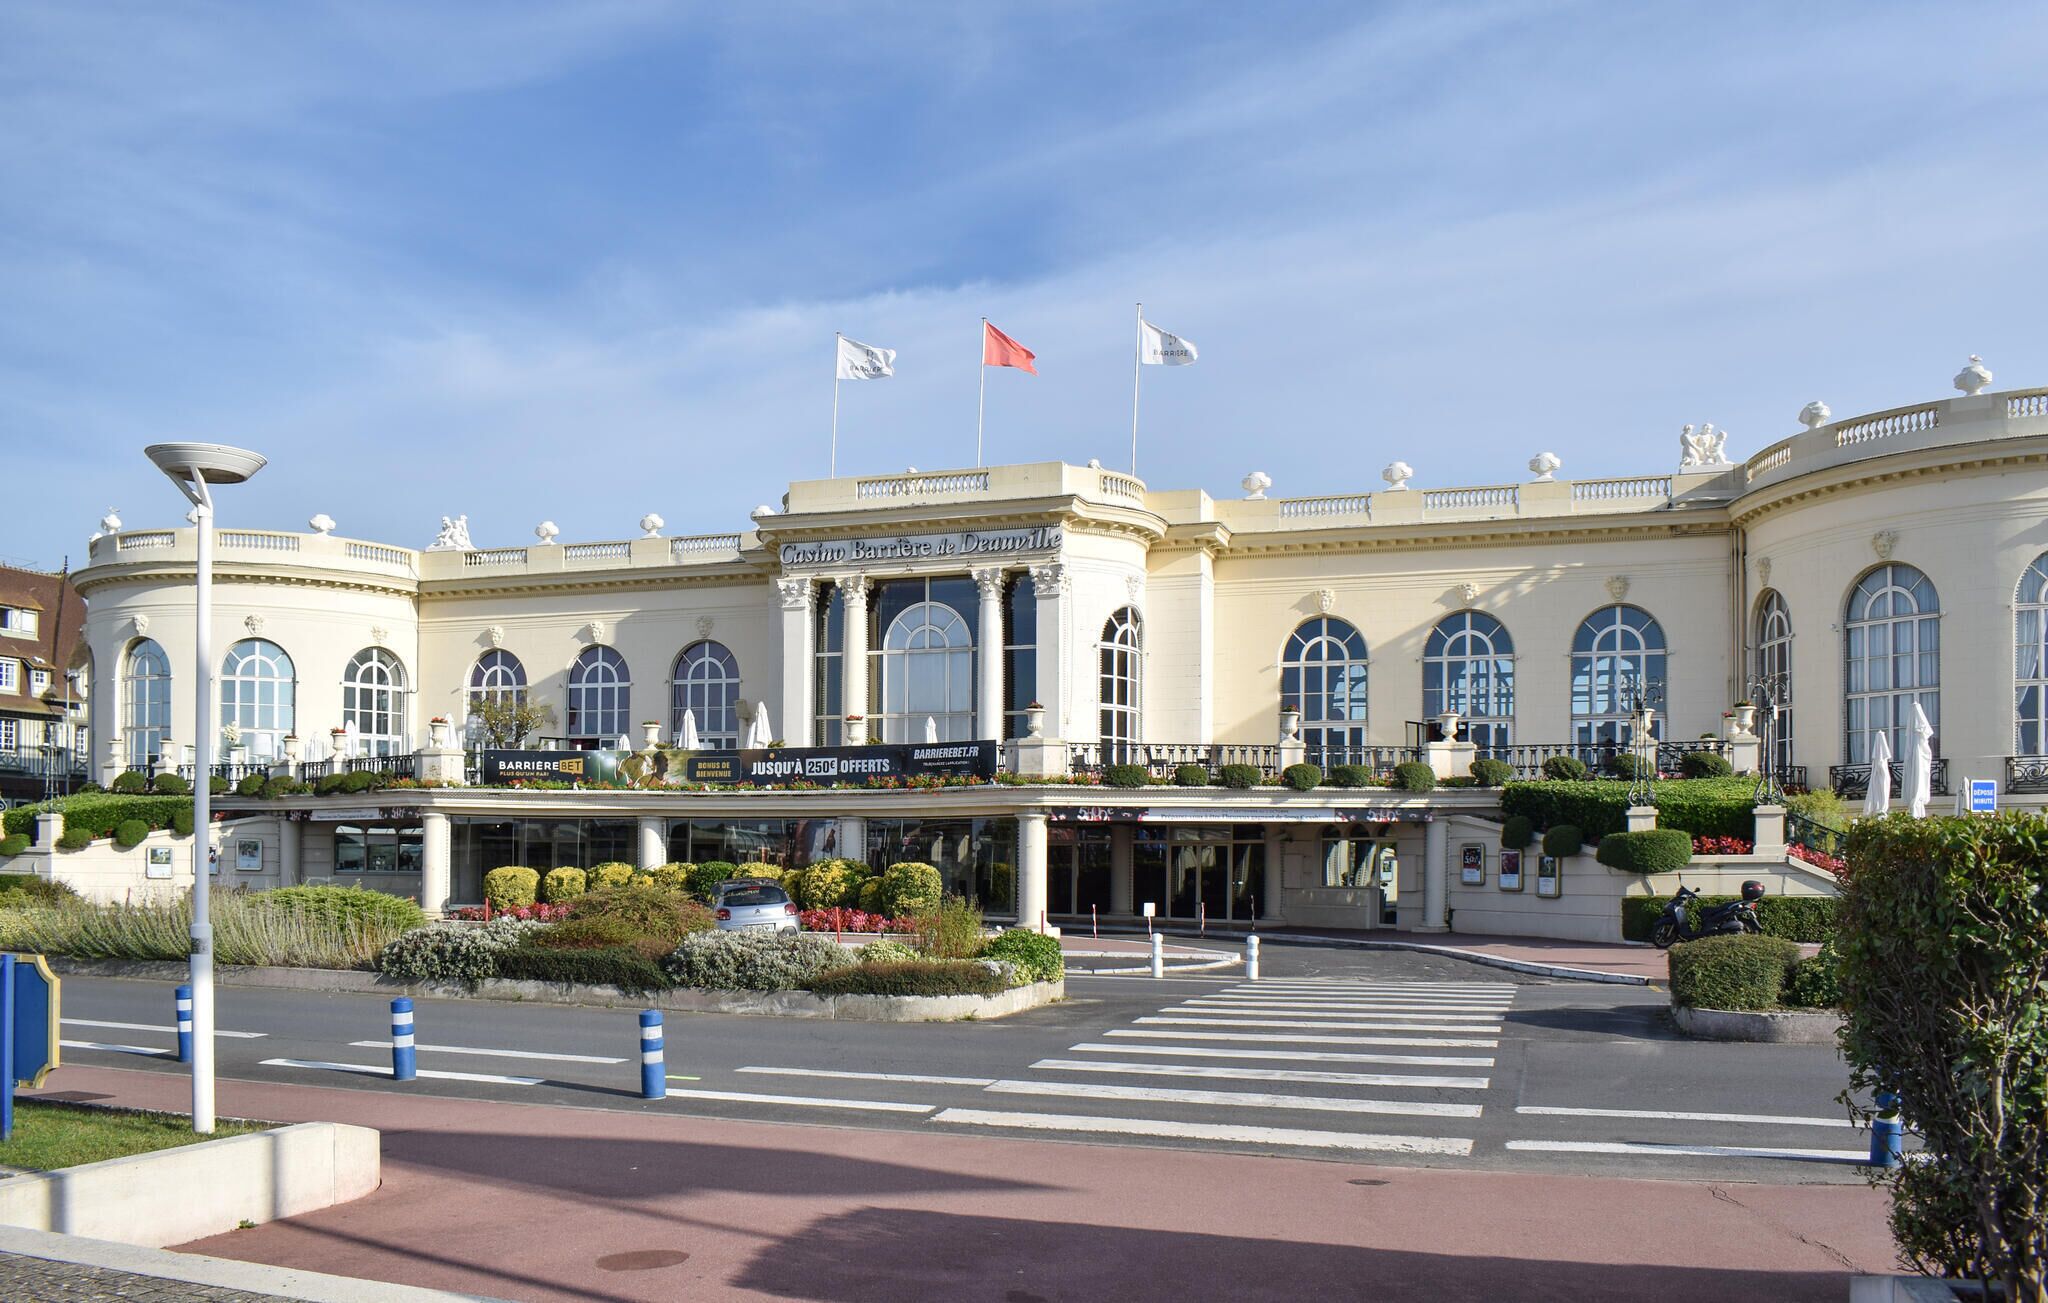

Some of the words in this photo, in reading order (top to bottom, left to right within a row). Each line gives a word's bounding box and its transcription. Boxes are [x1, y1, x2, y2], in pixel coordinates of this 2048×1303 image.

[780, 543, 845, 564] Casino
[851, 538, 931, 560] Barrière
[936, 538, 956, 555] de
[959, 526, 1062, 553] Deauville
[913, 746, 979, 760] BARRIEREBET.FR
[721, 761, 730, 769] DE
[751, 758, 804, 778] JUSQU'À
[807, 759, 836, 774] 250€
[840, 758, 890, 773] OFFERTS
[695, 770, 732, 778] BIENVENUE
